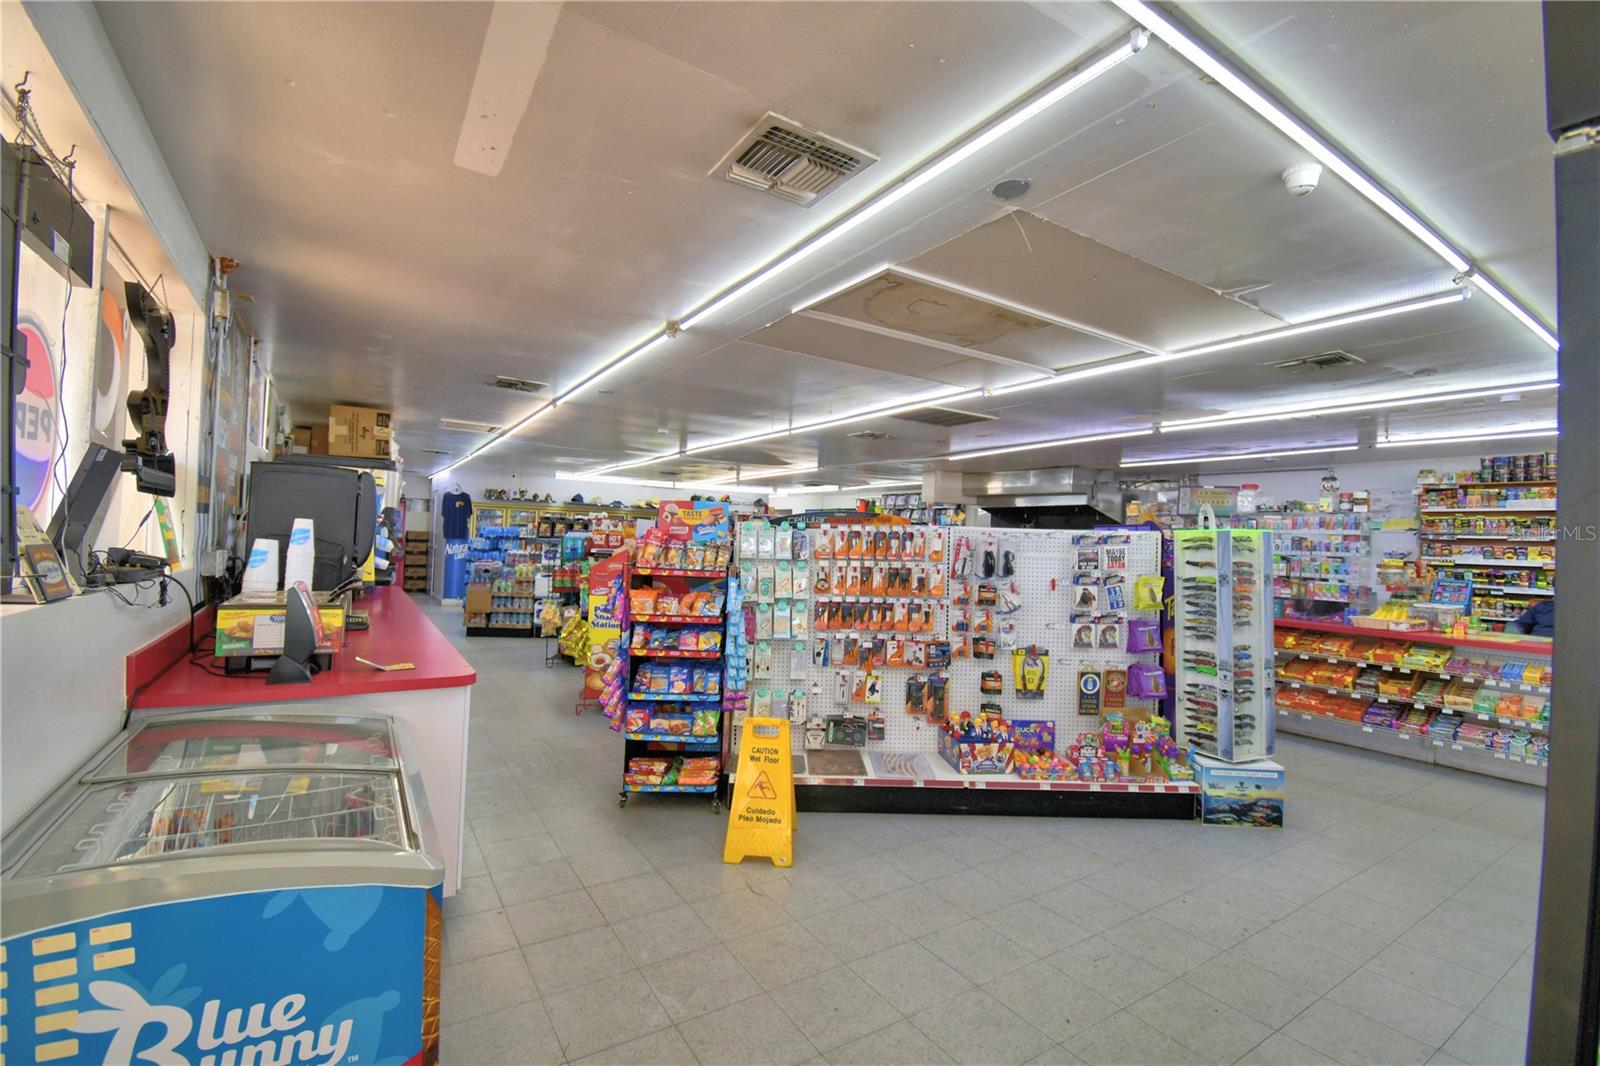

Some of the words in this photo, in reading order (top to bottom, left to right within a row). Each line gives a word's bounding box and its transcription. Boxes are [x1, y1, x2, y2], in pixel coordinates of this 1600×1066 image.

[751, 746, 779, 755] CAUTION
[764, 755, 780, 764] Floor
[746, 806, 776, 816] Cuidado
[738, 814, 754, 823] Piso
[756, 815, 782, 825] Mojado
